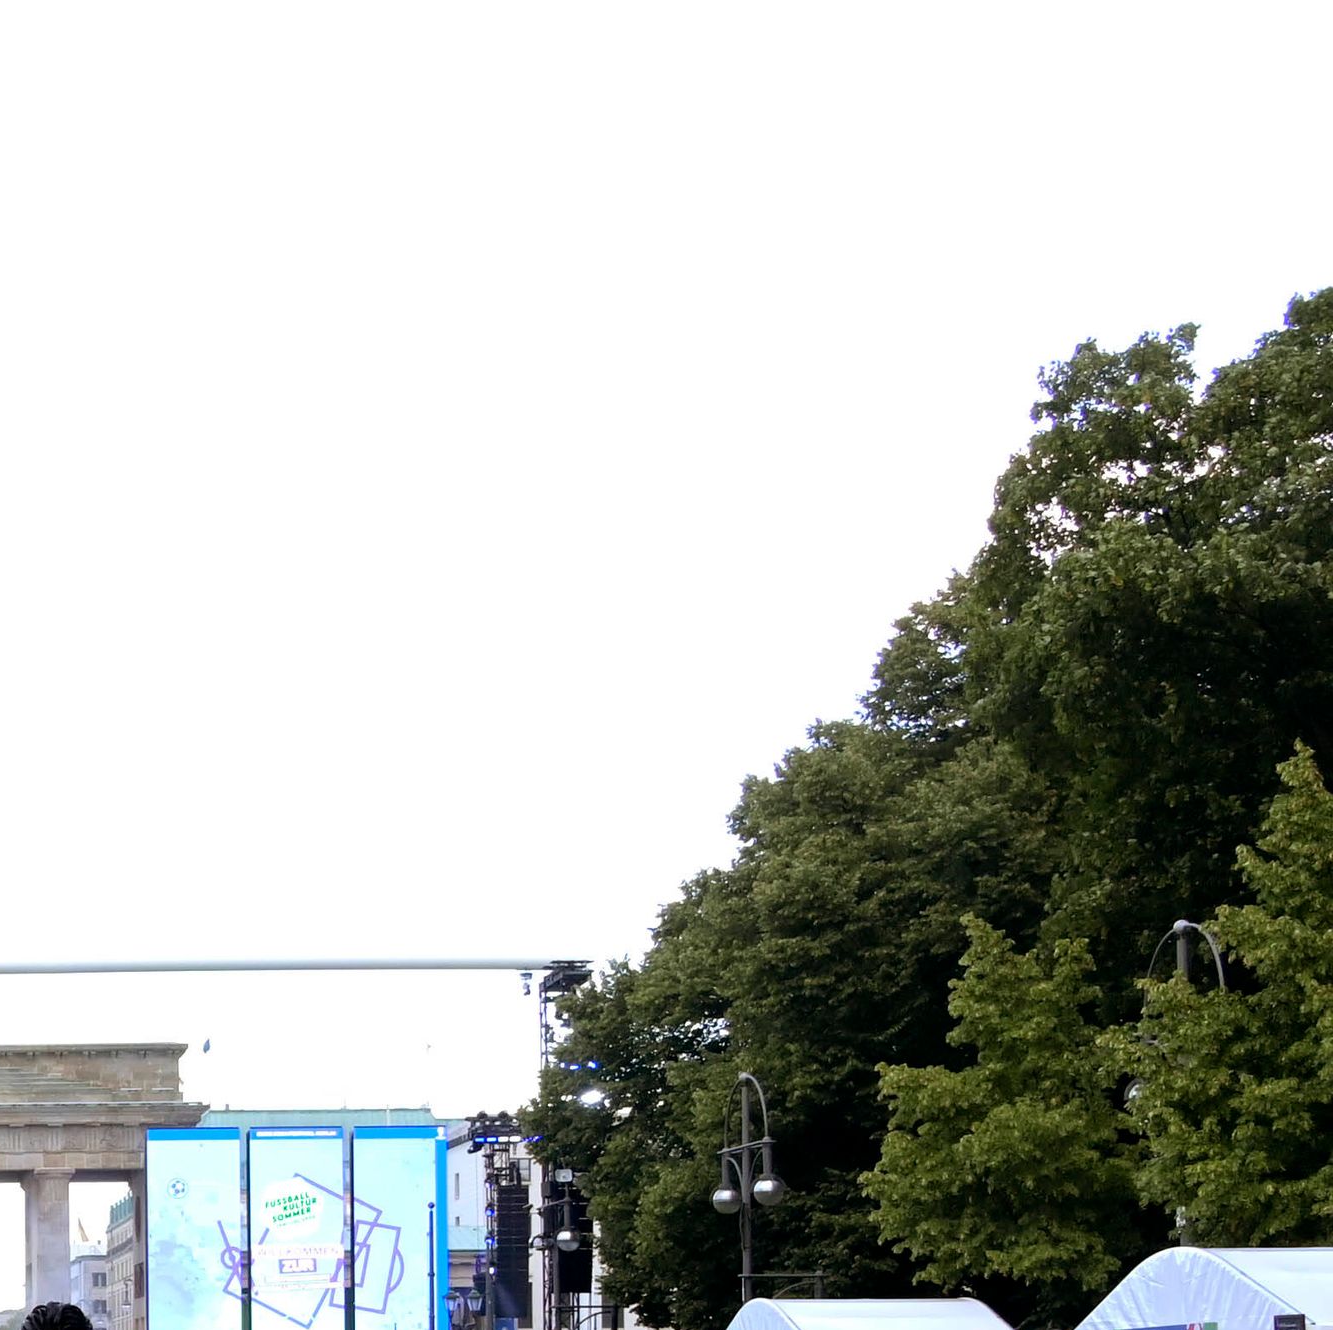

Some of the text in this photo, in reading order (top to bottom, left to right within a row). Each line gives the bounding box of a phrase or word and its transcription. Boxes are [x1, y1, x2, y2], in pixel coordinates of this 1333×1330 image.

[265, 1192, 309, 1209] FUSSBALL
[283, 1197, 317, 1211] KULTUR
[272, 1207, 311, 1222] SOMMER
